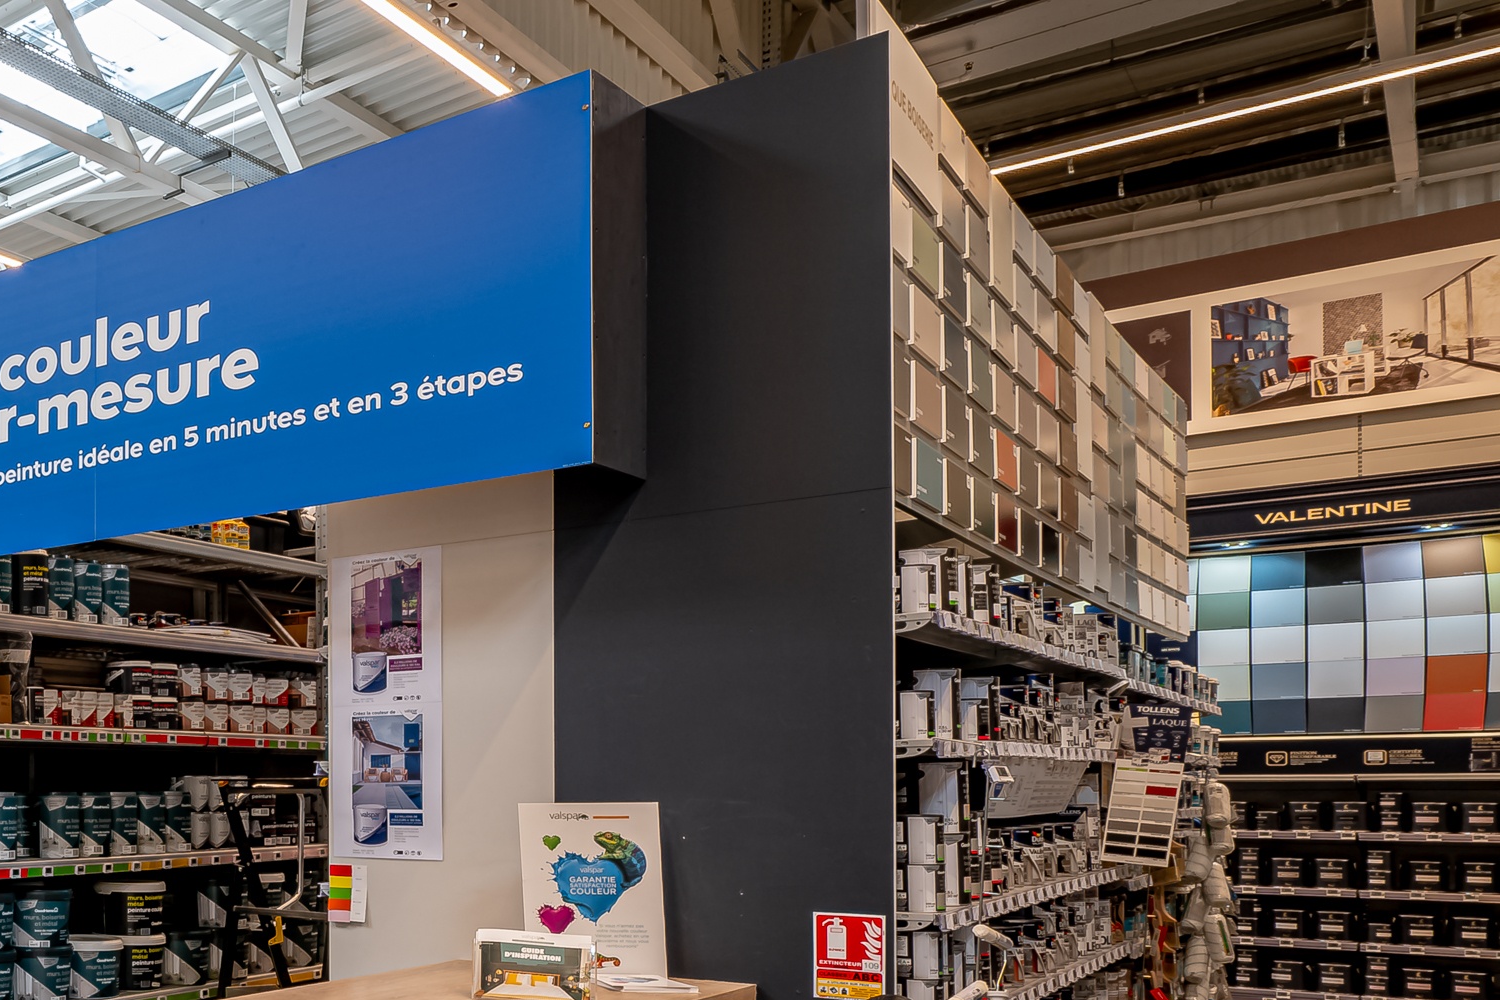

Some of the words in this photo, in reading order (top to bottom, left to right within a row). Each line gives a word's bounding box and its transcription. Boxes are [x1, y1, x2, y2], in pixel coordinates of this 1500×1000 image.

[77, 440, 144, 470] idéale
[149, 433, 177, 455] en
[183, 426, 200, 448] 5
[205, 408, 307, 444] minutes
[313, 397, 341, 422] et
[347, 392, 382, 415] en
[389, 382, 409, 406] 3
[416, 362, 524, 401] étapes
[1255, 498, 1411, 525] VALENTINE
[359, 659, 380, 667] valspar
[1136, 706, 1180, 714] TOLLENS
[1152, 718, 1188, 727] LAQUE
[360, 812, 381, 821] valspar
[549, 811, 584, 822] valspar
[579, 866, 605, 874] valspar
[569, 876, 616, 884] GARANTIE
[569, 887, 617, 896] COULEUR
[504, 951, 562, 962] D'INSPIRATION
[131, 959, 155, 967] peinture
[819, 959, 862, 967] EXTINCTEUR
[863, 962, 880, 970] 109
[852, 972, 879, 982] ABC
